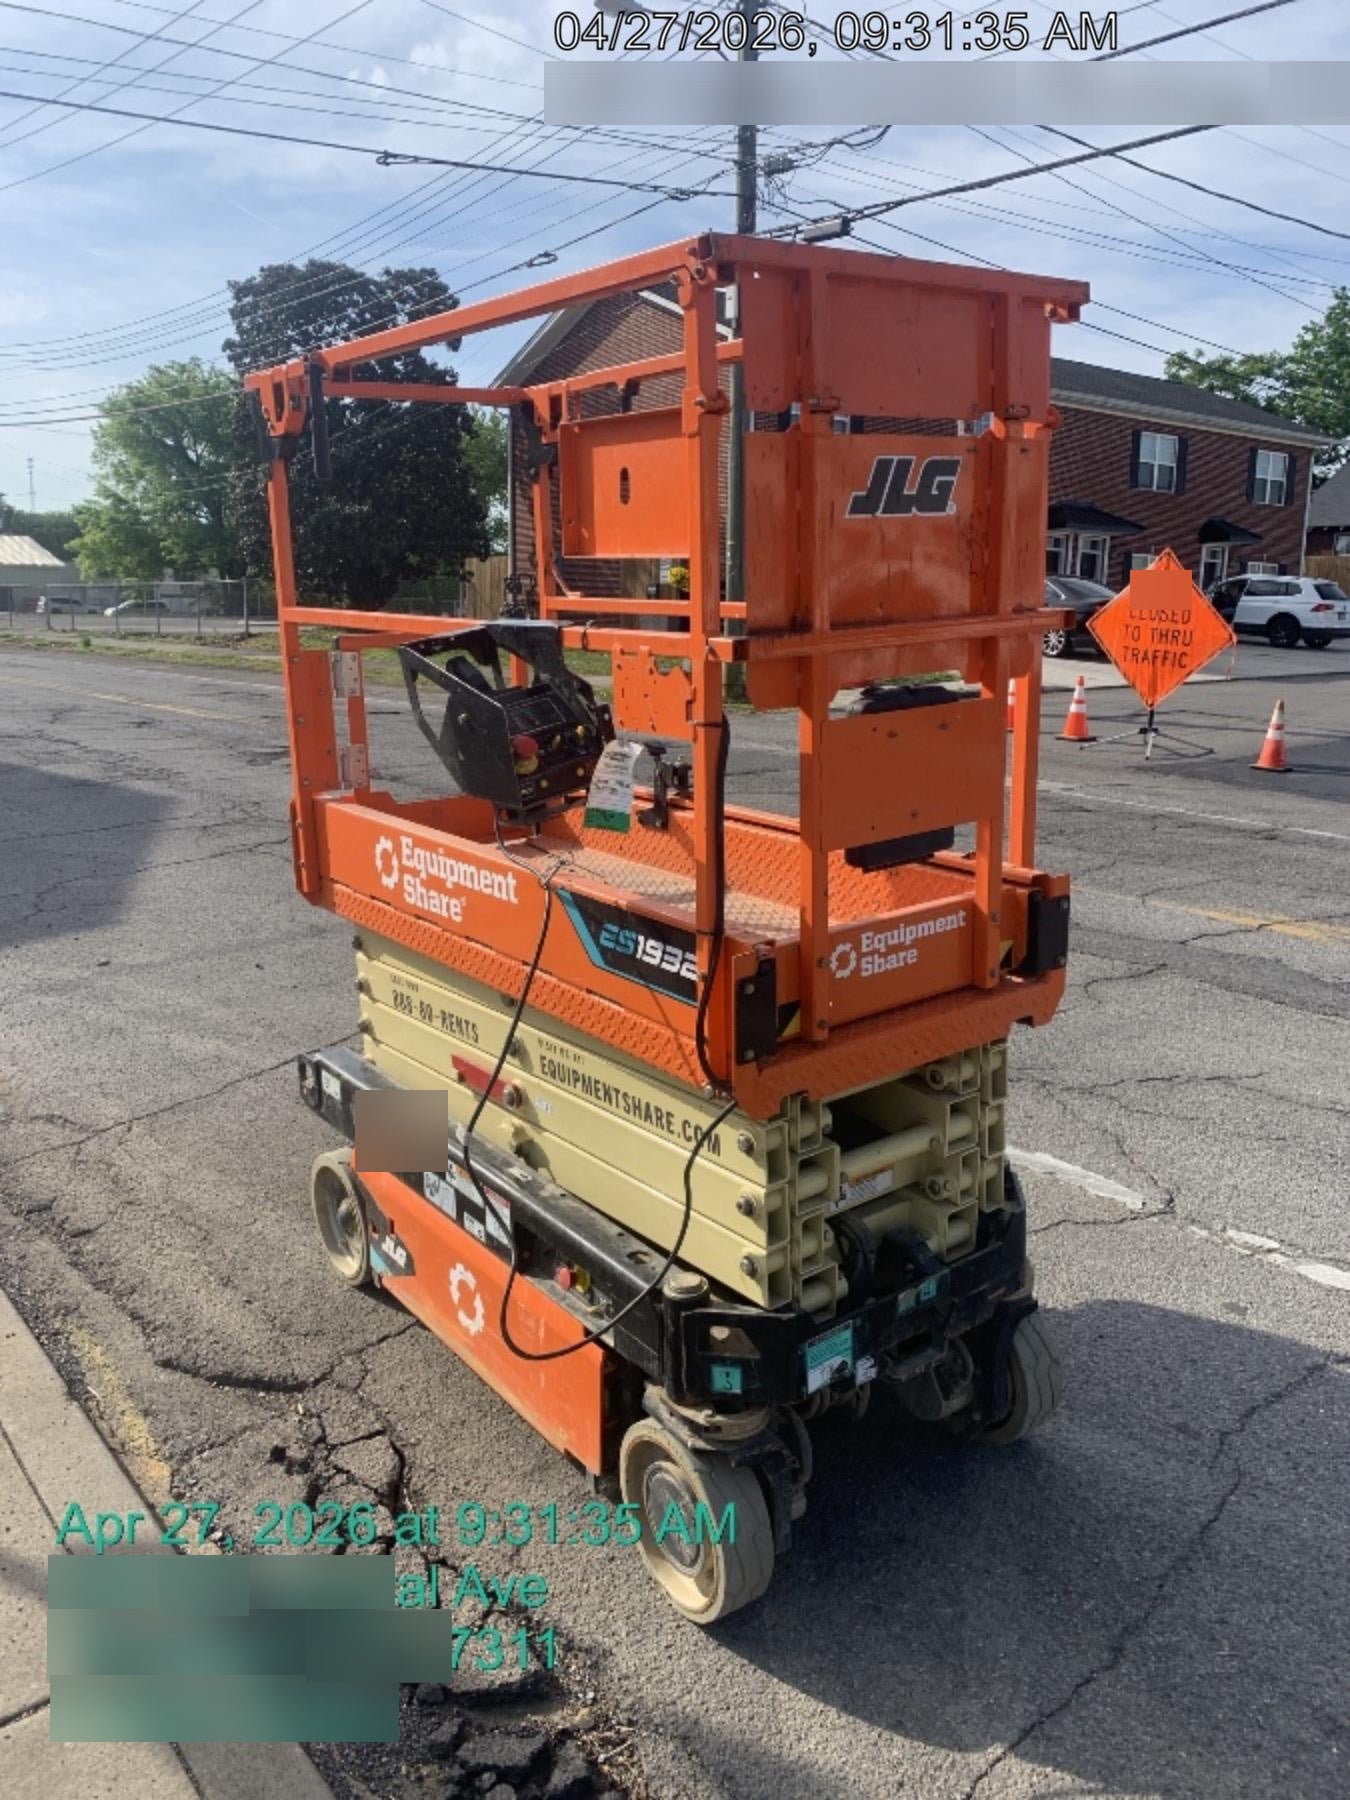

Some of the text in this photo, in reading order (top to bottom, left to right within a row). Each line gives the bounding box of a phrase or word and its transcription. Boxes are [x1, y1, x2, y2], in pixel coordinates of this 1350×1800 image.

[845, 455, 962, 518] JLG
[1122, 645, 1189, 669] TRAFFIC
[1123, 623, 1193, 647] TO THRU
[400, 835, 519, 905] Equipment
[600, 922, 697, 982] ES1932
[860, 909, 967, 953] Equipment
[860, 949, 918, 977] Share
[539, 1055, 722, 1157] EQUIPMENTSHARE.COM
